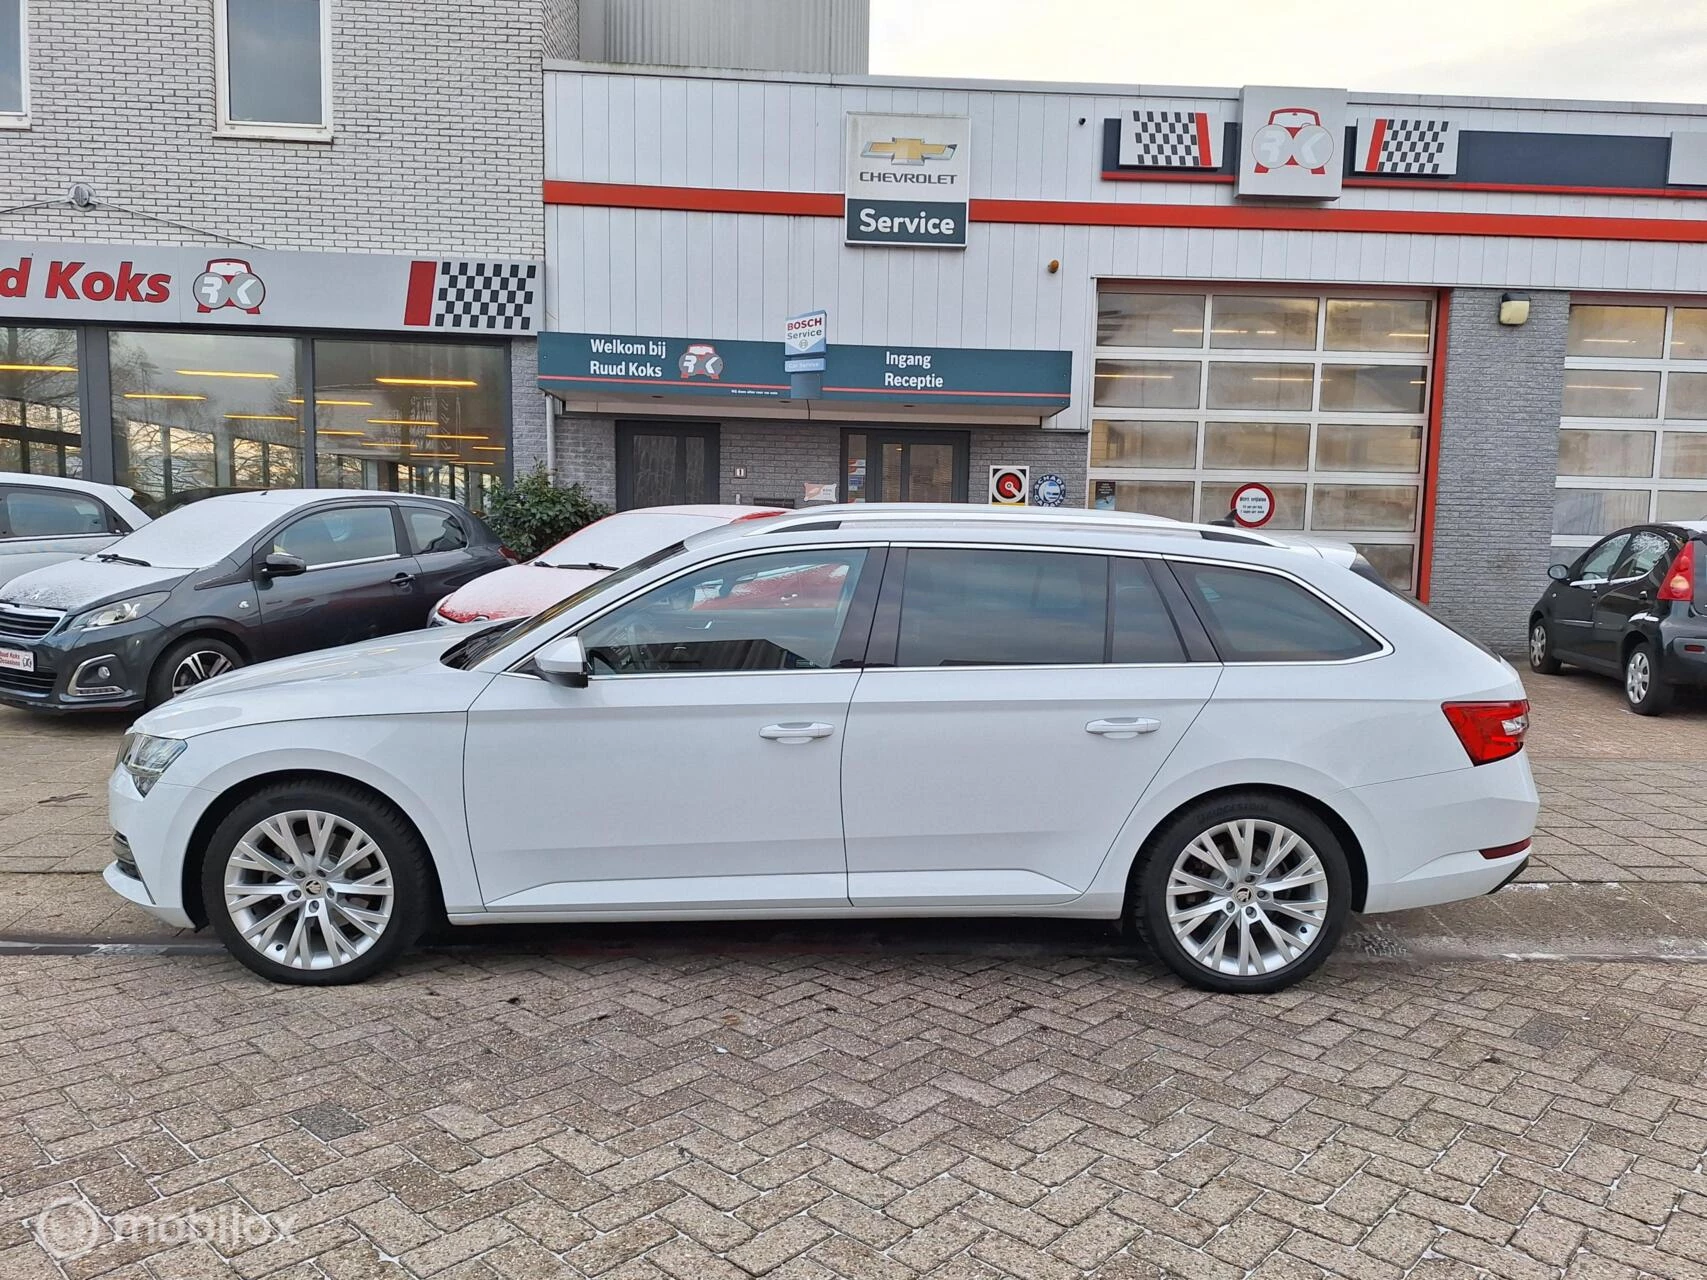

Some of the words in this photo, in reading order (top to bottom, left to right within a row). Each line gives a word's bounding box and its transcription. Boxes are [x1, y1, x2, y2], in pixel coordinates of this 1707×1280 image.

[859, 171, 958, 185] CHEVROLET
[859, 207, 955, 235] Service
[45, 260, 171, 303] Koks
[787, 317, 822, 331] BOSCH
[787, 329, 822, 340] Service
[590, 338, 646, 355] Welkom
[649, 341, 667, 359] bij
[590, 360, 626, 376] Ruud
[628, 362, 663, 377] Koks
[885, 351, 931, 369] Ingang
[884, 372, 944, 390] Receptie
